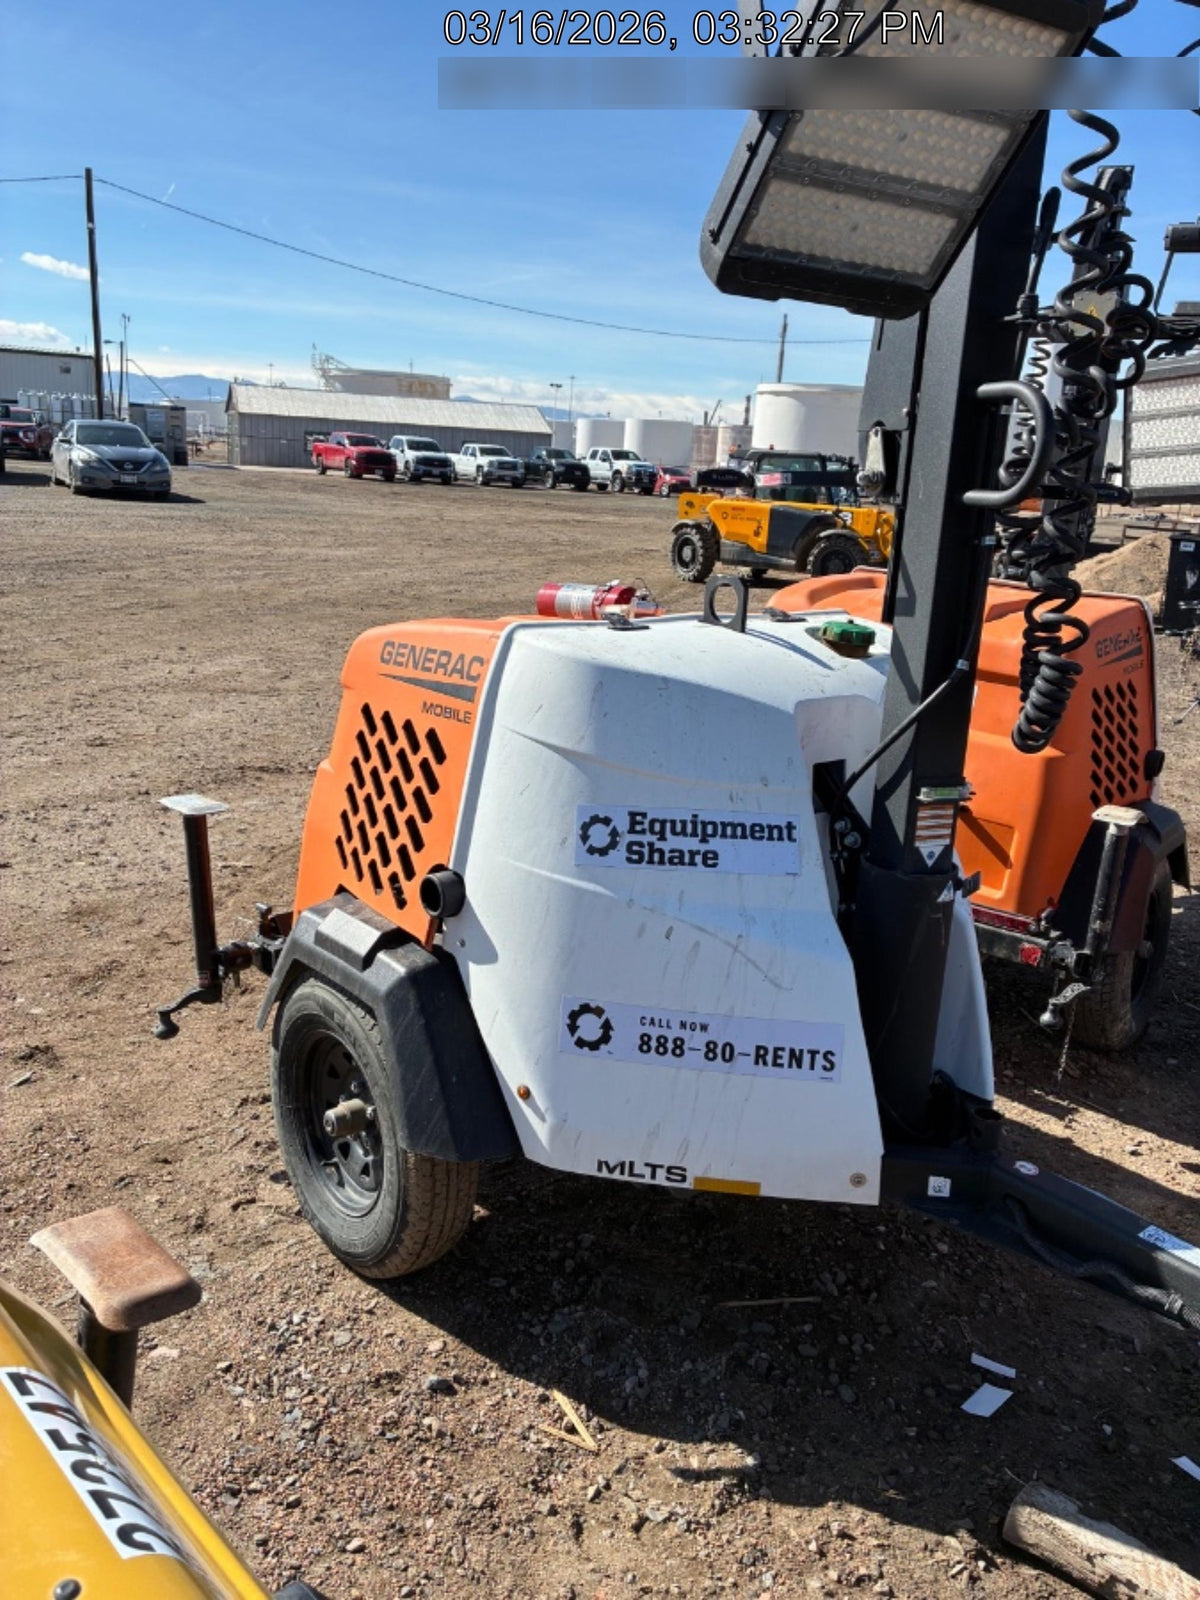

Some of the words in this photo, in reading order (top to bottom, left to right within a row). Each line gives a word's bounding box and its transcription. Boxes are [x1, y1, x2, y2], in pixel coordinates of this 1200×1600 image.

[380, 639, 484, 683] GENERAC
[421, 700, 472, 724] MOBILE
[627, 811, 797, 843] Equipment
[625, 840, 719, 868] Share
[639, 1016, 673, 1030] CALL
[679, 1019, 710, 1033] NOW
[638, 1033, 836, 1073] 888-80-RENTS
[597, 1159, 687, 1183] MLTS
